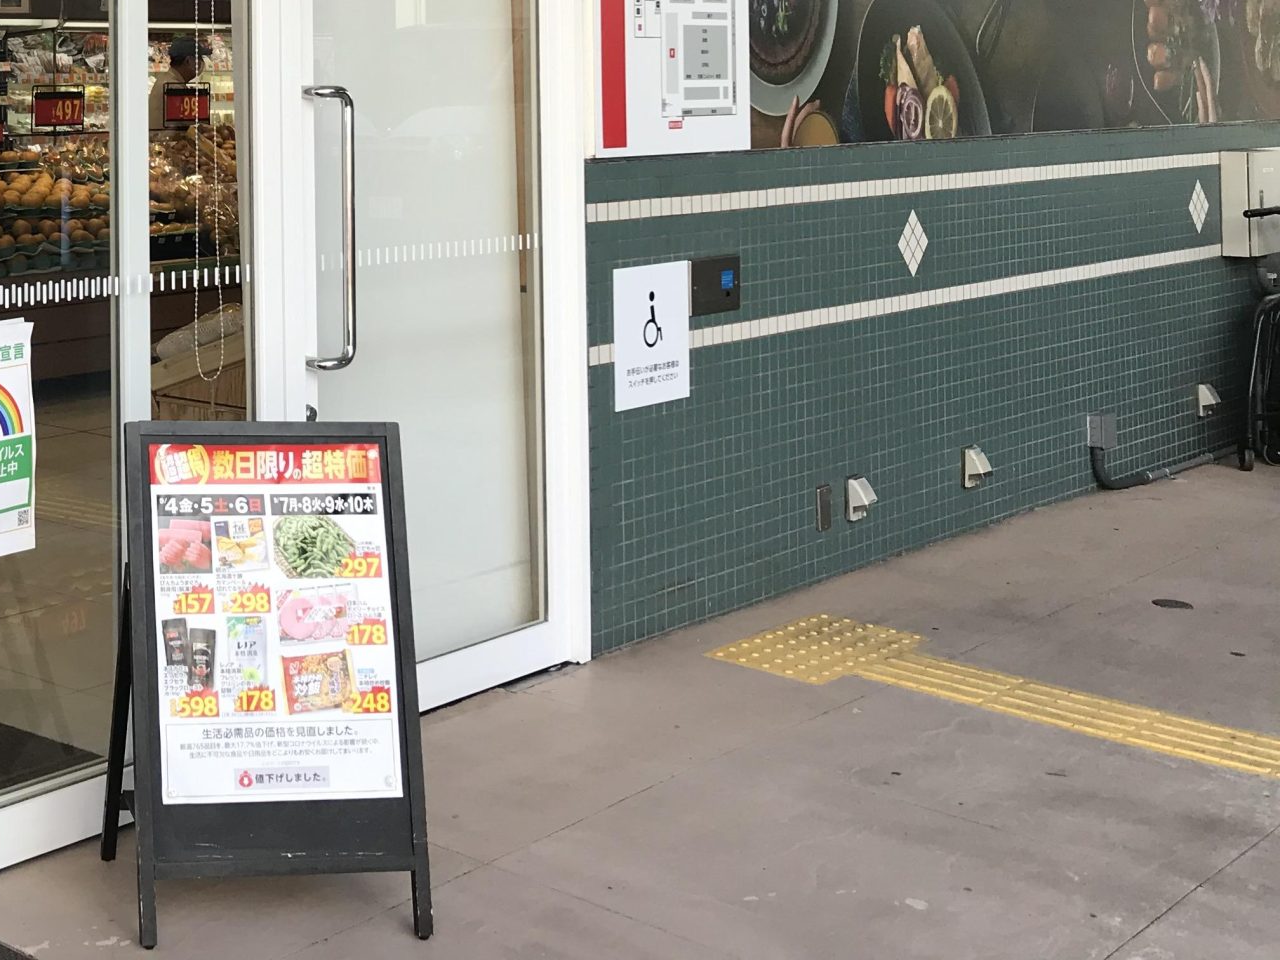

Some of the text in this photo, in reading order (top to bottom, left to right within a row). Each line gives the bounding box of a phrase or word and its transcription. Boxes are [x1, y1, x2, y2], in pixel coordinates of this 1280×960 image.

[212, 449, 368, 481] 数日限りの超特価
